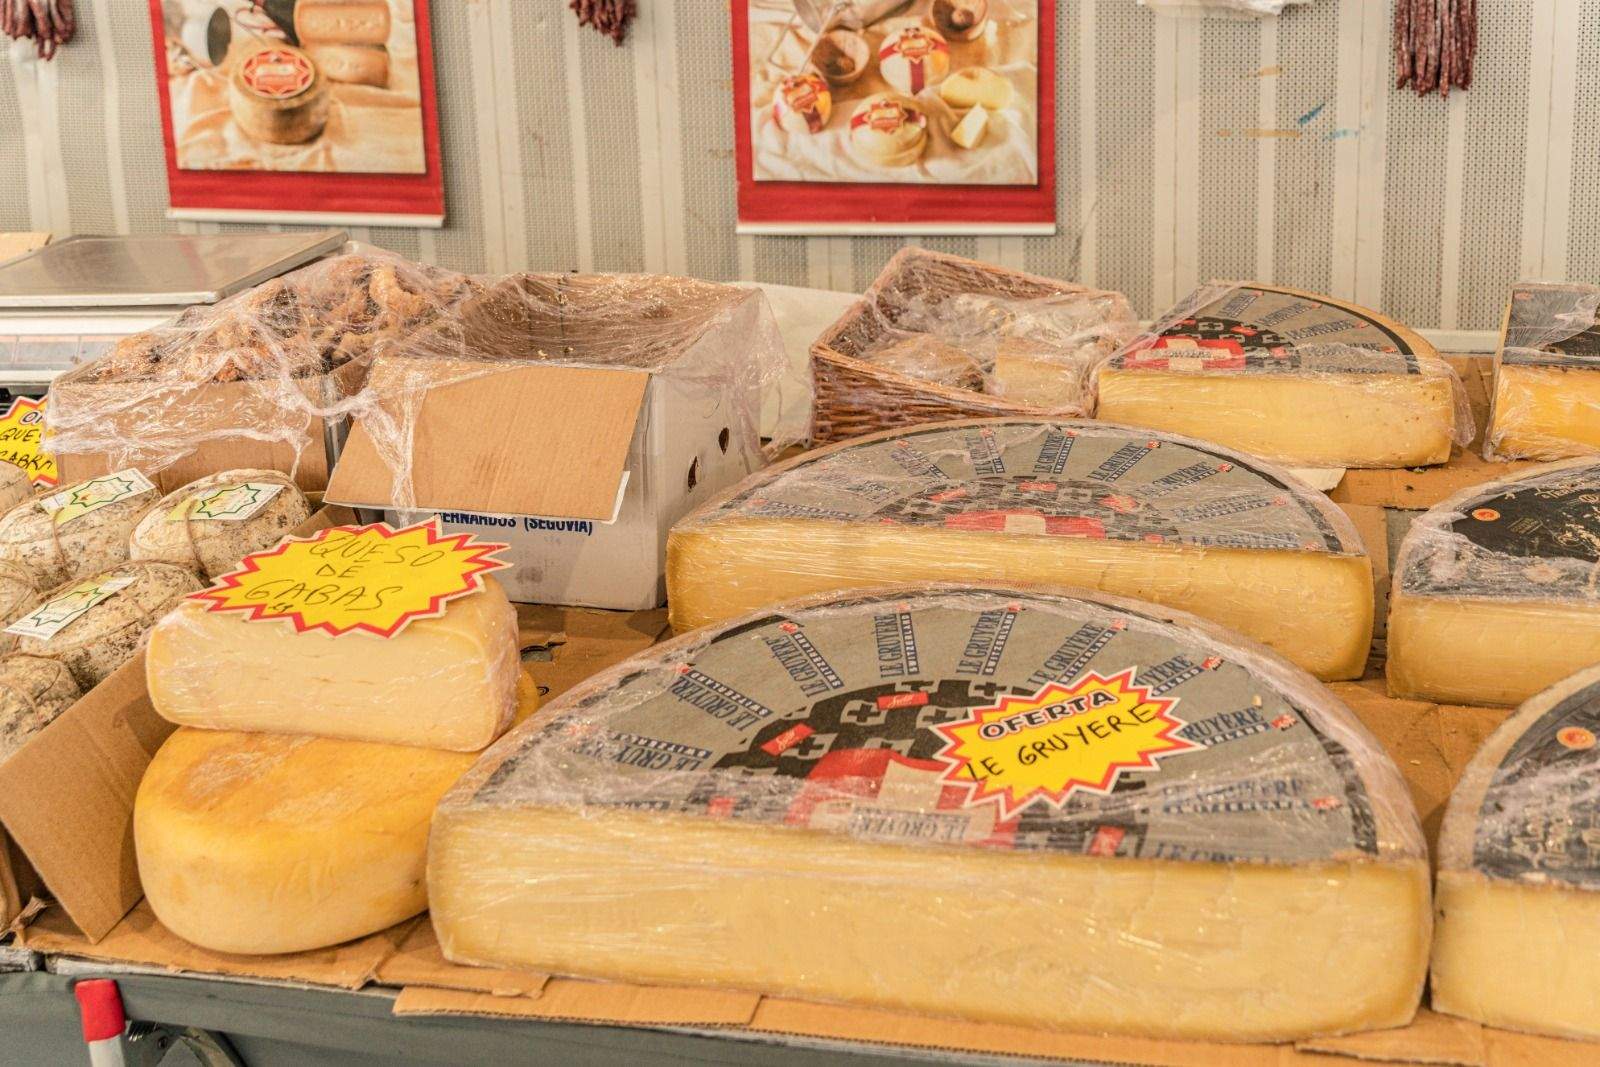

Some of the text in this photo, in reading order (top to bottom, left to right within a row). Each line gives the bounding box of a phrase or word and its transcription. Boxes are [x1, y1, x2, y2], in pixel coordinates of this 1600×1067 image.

[0, 427, 41, 443] QUE
[434, 512, 593, 536] ERNARDOS (SEGOVIA)
[309, 535, 445, 567] QUESO
[316, 563, 364, 578] DE
[245, 579, 403, 611] GABAS
[902, 613, 919, 675] SWITZERLAND
[983, 612, 1017, 676] SWITZERLAND
[1058, 629, 1117, 685] WITZERLAND
[793, 632, 844, 689] SWITZERLAND
[880, 663, 905, 678] LE
[956, 659, 983, 676] LE
[1134, 653, 1194, 686] UYÈRE
[689, 670, 771, 717] SWITZERLAND
[801, 679, 830, 698] LE
[1027, 669, 1056, 686] LE
[726, 715, 761, 731] LE
[982, 690, 1117, 738] OFERTA
[1180, 706, 1265, 740] RUYÈRE
[966, 703, 1157, 782] LE GRUYERE
[1201, 723, 1269, 747] ERLAND
